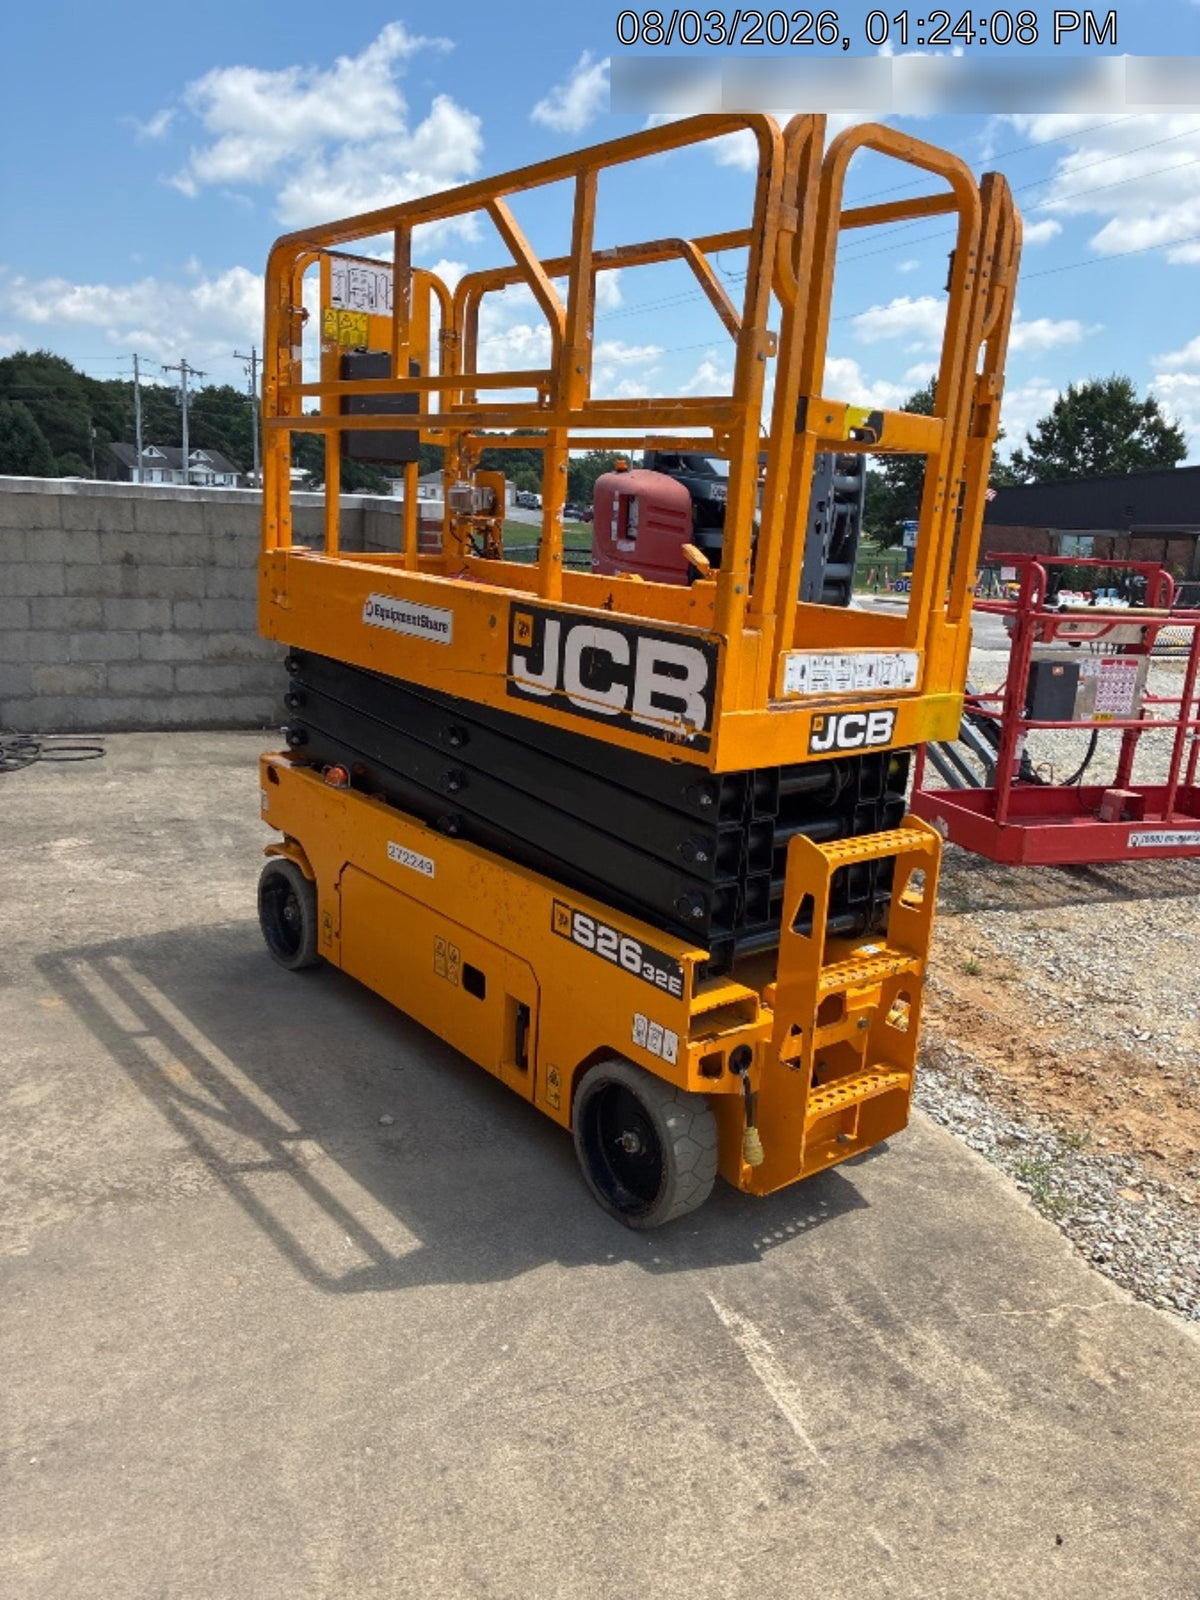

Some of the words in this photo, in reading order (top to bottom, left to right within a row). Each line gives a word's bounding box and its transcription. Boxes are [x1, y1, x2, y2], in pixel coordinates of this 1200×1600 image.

[374, 604, 449, 633] EquipmentShare
[512, 618, 708, 733] JCB
[811, 711, 895, 751] JCB
[388, 845, 433, 874] 272249
[572, 912, 643, 974] S26
[643, 962, 682, 996] 32E
